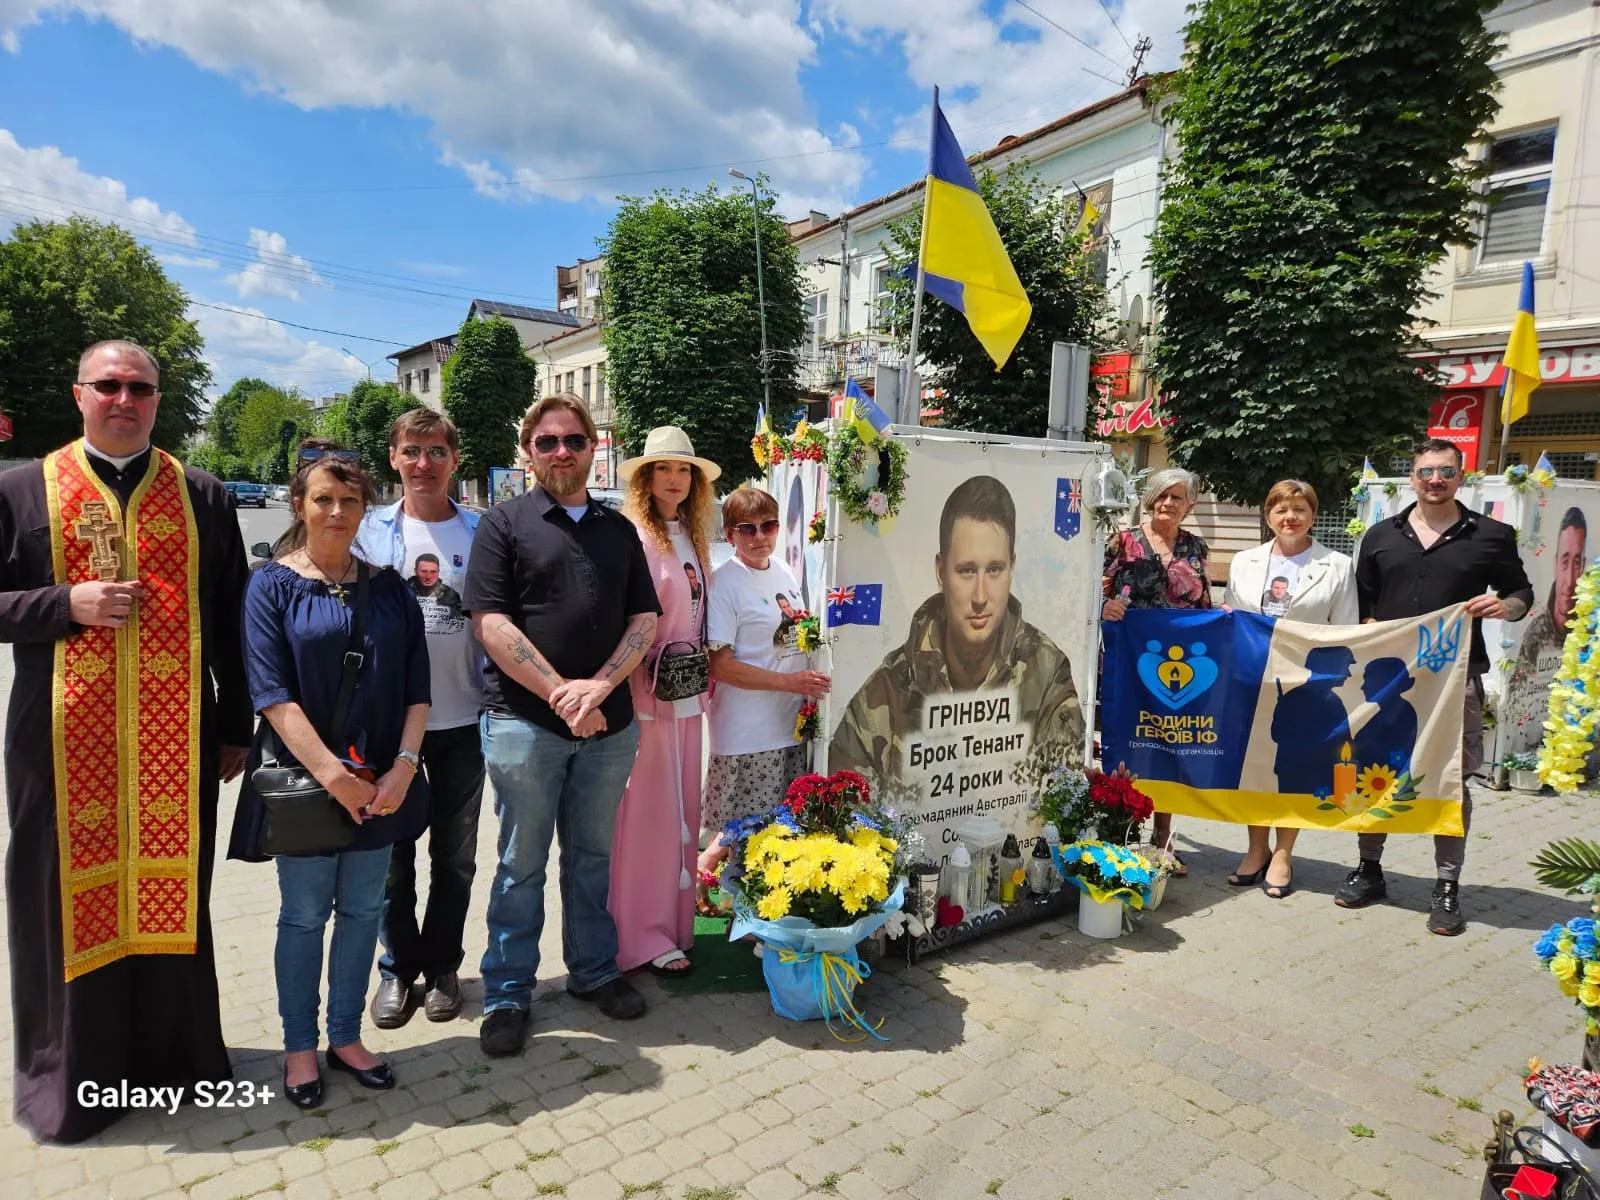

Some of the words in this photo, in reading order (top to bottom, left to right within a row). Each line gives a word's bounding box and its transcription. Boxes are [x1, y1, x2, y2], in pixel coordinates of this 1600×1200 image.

[1436, 347, 1600, 386] БУОВ
[929, 697, 1011, 729] ГРІНВУД
[1139, 710, 1214, 730] РОДИНИ
[1135, 725, 1194, 744] ГЕРОЇВ
[1197, 730, 1218, 744] ІФ
[910, 743, 958, 770] Брок
[962, 733, 1025, 758] Тенант
[930, 772, 955, 798] 24
[959, 769, 1003, 798] роки
[976, 789, 1028, 812] Австралії
